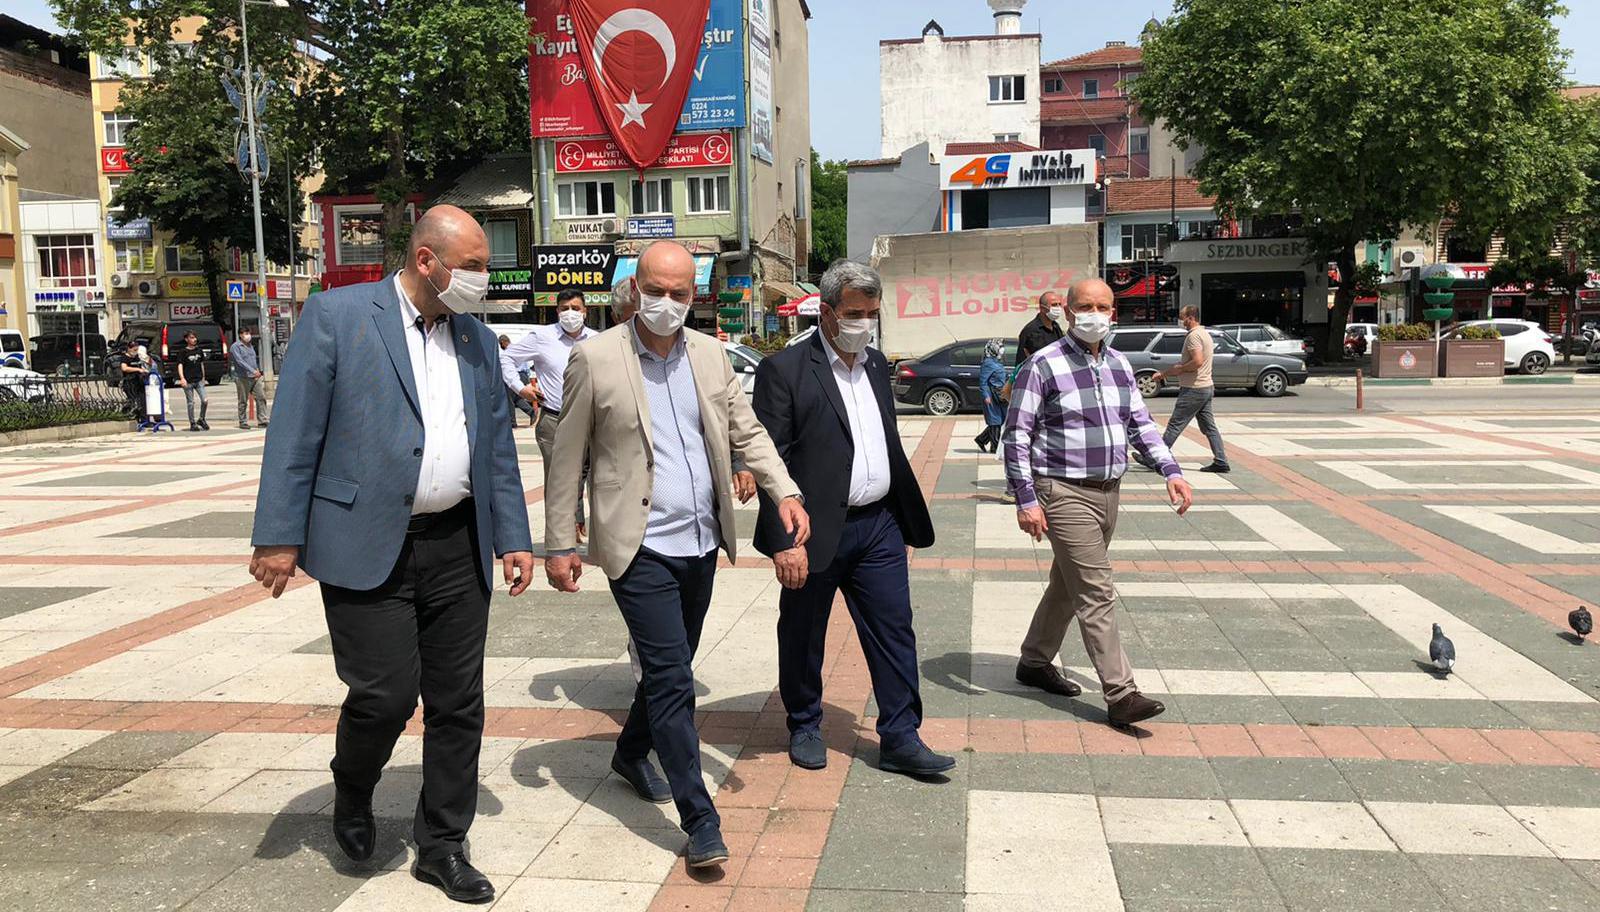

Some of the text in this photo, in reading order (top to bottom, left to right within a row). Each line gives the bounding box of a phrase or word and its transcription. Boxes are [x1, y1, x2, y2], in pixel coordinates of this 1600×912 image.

[556, 13, 574, 34] Eğ
[701, 27, 734, 49] ştır
[692, 102, 707, 110] 0224
[692, 108, 735, 119] 573 23 24
[586, 147, 699, 159] MİLLİYET PARTİSİ
[1032, 151, 1072, 168] EV & İŞ
[592, 158, 617, 167] KADIN
[658, 155, 694, 165] EŞKİLATI
[950, 155, 1011, 186] 4G
[1019, 164, 1084, 182] İNTERNETİ
[568, 223, 603, 233] AVUKAT
[537, 249, 610, 269] pazarköy
[546, 268, 604, 285] DÖNER
[35, 292, 75, 302] SAMSUNG
[94, 291, 105, 300] LG
[173, 306, 211, 317] ECZAN
[945, 294, 1039, 315] LOJİS
